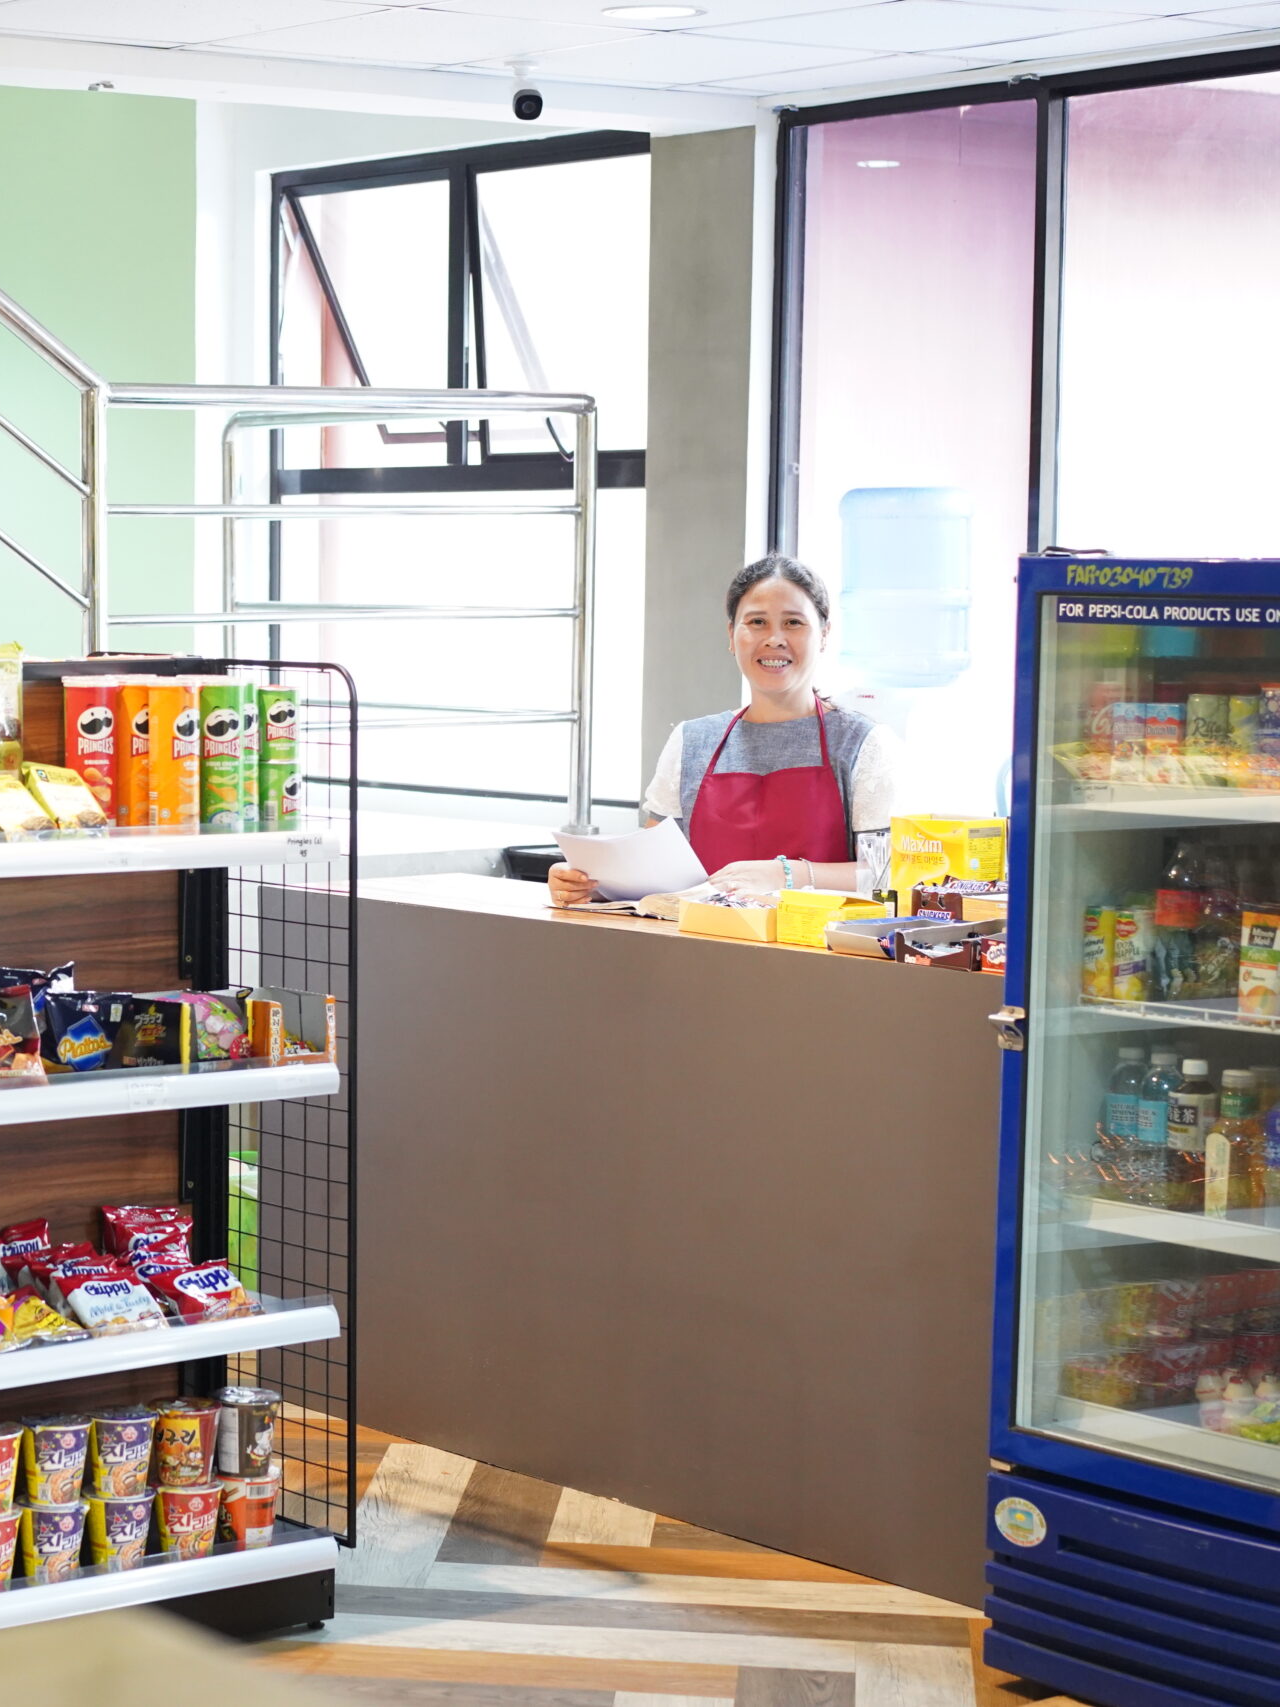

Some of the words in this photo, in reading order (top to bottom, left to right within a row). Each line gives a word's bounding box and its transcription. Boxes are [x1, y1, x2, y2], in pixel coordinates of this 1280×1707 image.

[1059, 603, 1083, 617] FOR
[1089, 605, 1159, 620] PEPSI-COLA
[1164, 607, 1231, 622] PRODUCTS
[1236, 609, 1261, 622] USE
[78, 737, 114, 755] PRINGLES
[204, 740, 240, 758] PRINGLES
[902, 833, 943, 853] Maxim
[57, 1034, 113, 1064] Piattos
[85, 1279, 132, 1297] Chippy
